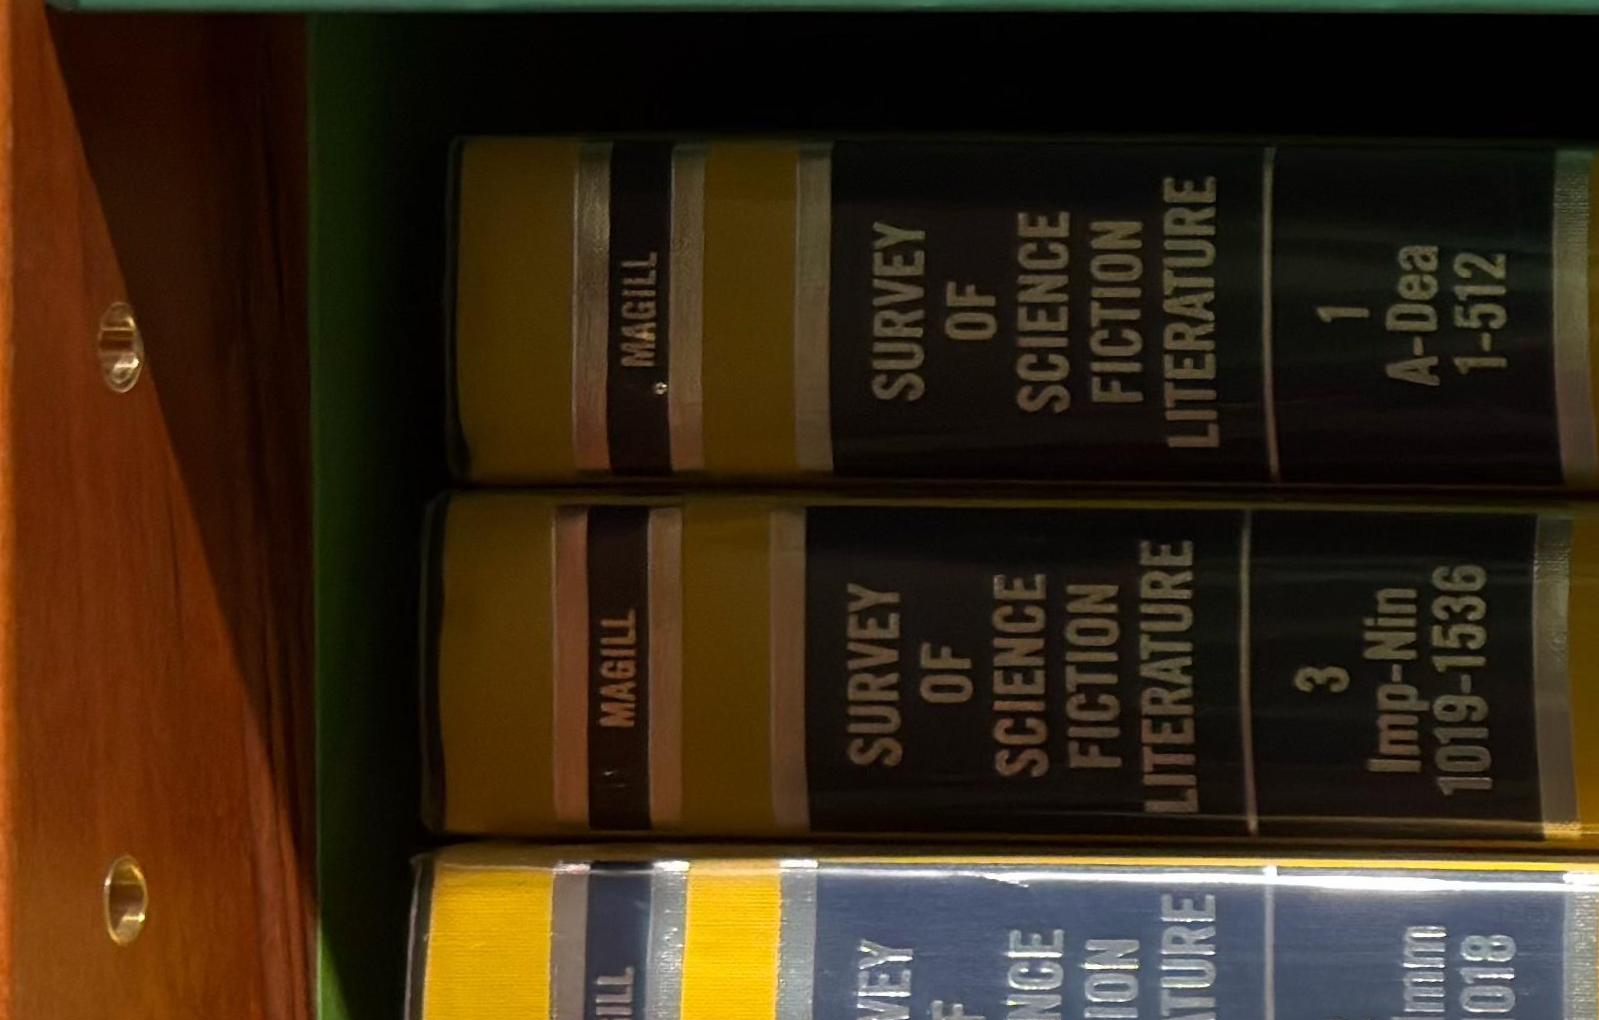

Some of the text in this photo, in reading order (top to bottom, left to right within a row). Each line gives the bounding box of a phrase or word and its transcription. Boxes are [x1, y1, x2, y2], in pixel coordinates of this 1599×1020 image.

[621, 249, 658, 369] MAGILL
[873, 221, 927, 401] SURVEY
[947, 280, 998, 340] OF
[1017, 209, 1072, 413] SCIENCE
[1091, 219, 1144, 404] FICTION
[1164, 176, 1218, 449] LITERATURE
[1318, 305, 1370, 323] 1
[1386, 245, 1438, 387] A-Dea
[1455, 251, 1509, 373] 1-512
[598, 608, 637, 728] MAGILL
[847, 582, 904, 767] SURVEY
[920, 643, 974, 703] OF
[996, 573, 1048, 778] SCIENCE
[1067, 582, 1121, 769] FICTION
[1139, 539, 1199, 815] LITERATURE
[1295, 664, 1350, 693] 3
[1365, 586, 1420, 774] Imp-Nin
[1435, 563, 1492, 797] 1019-1536
